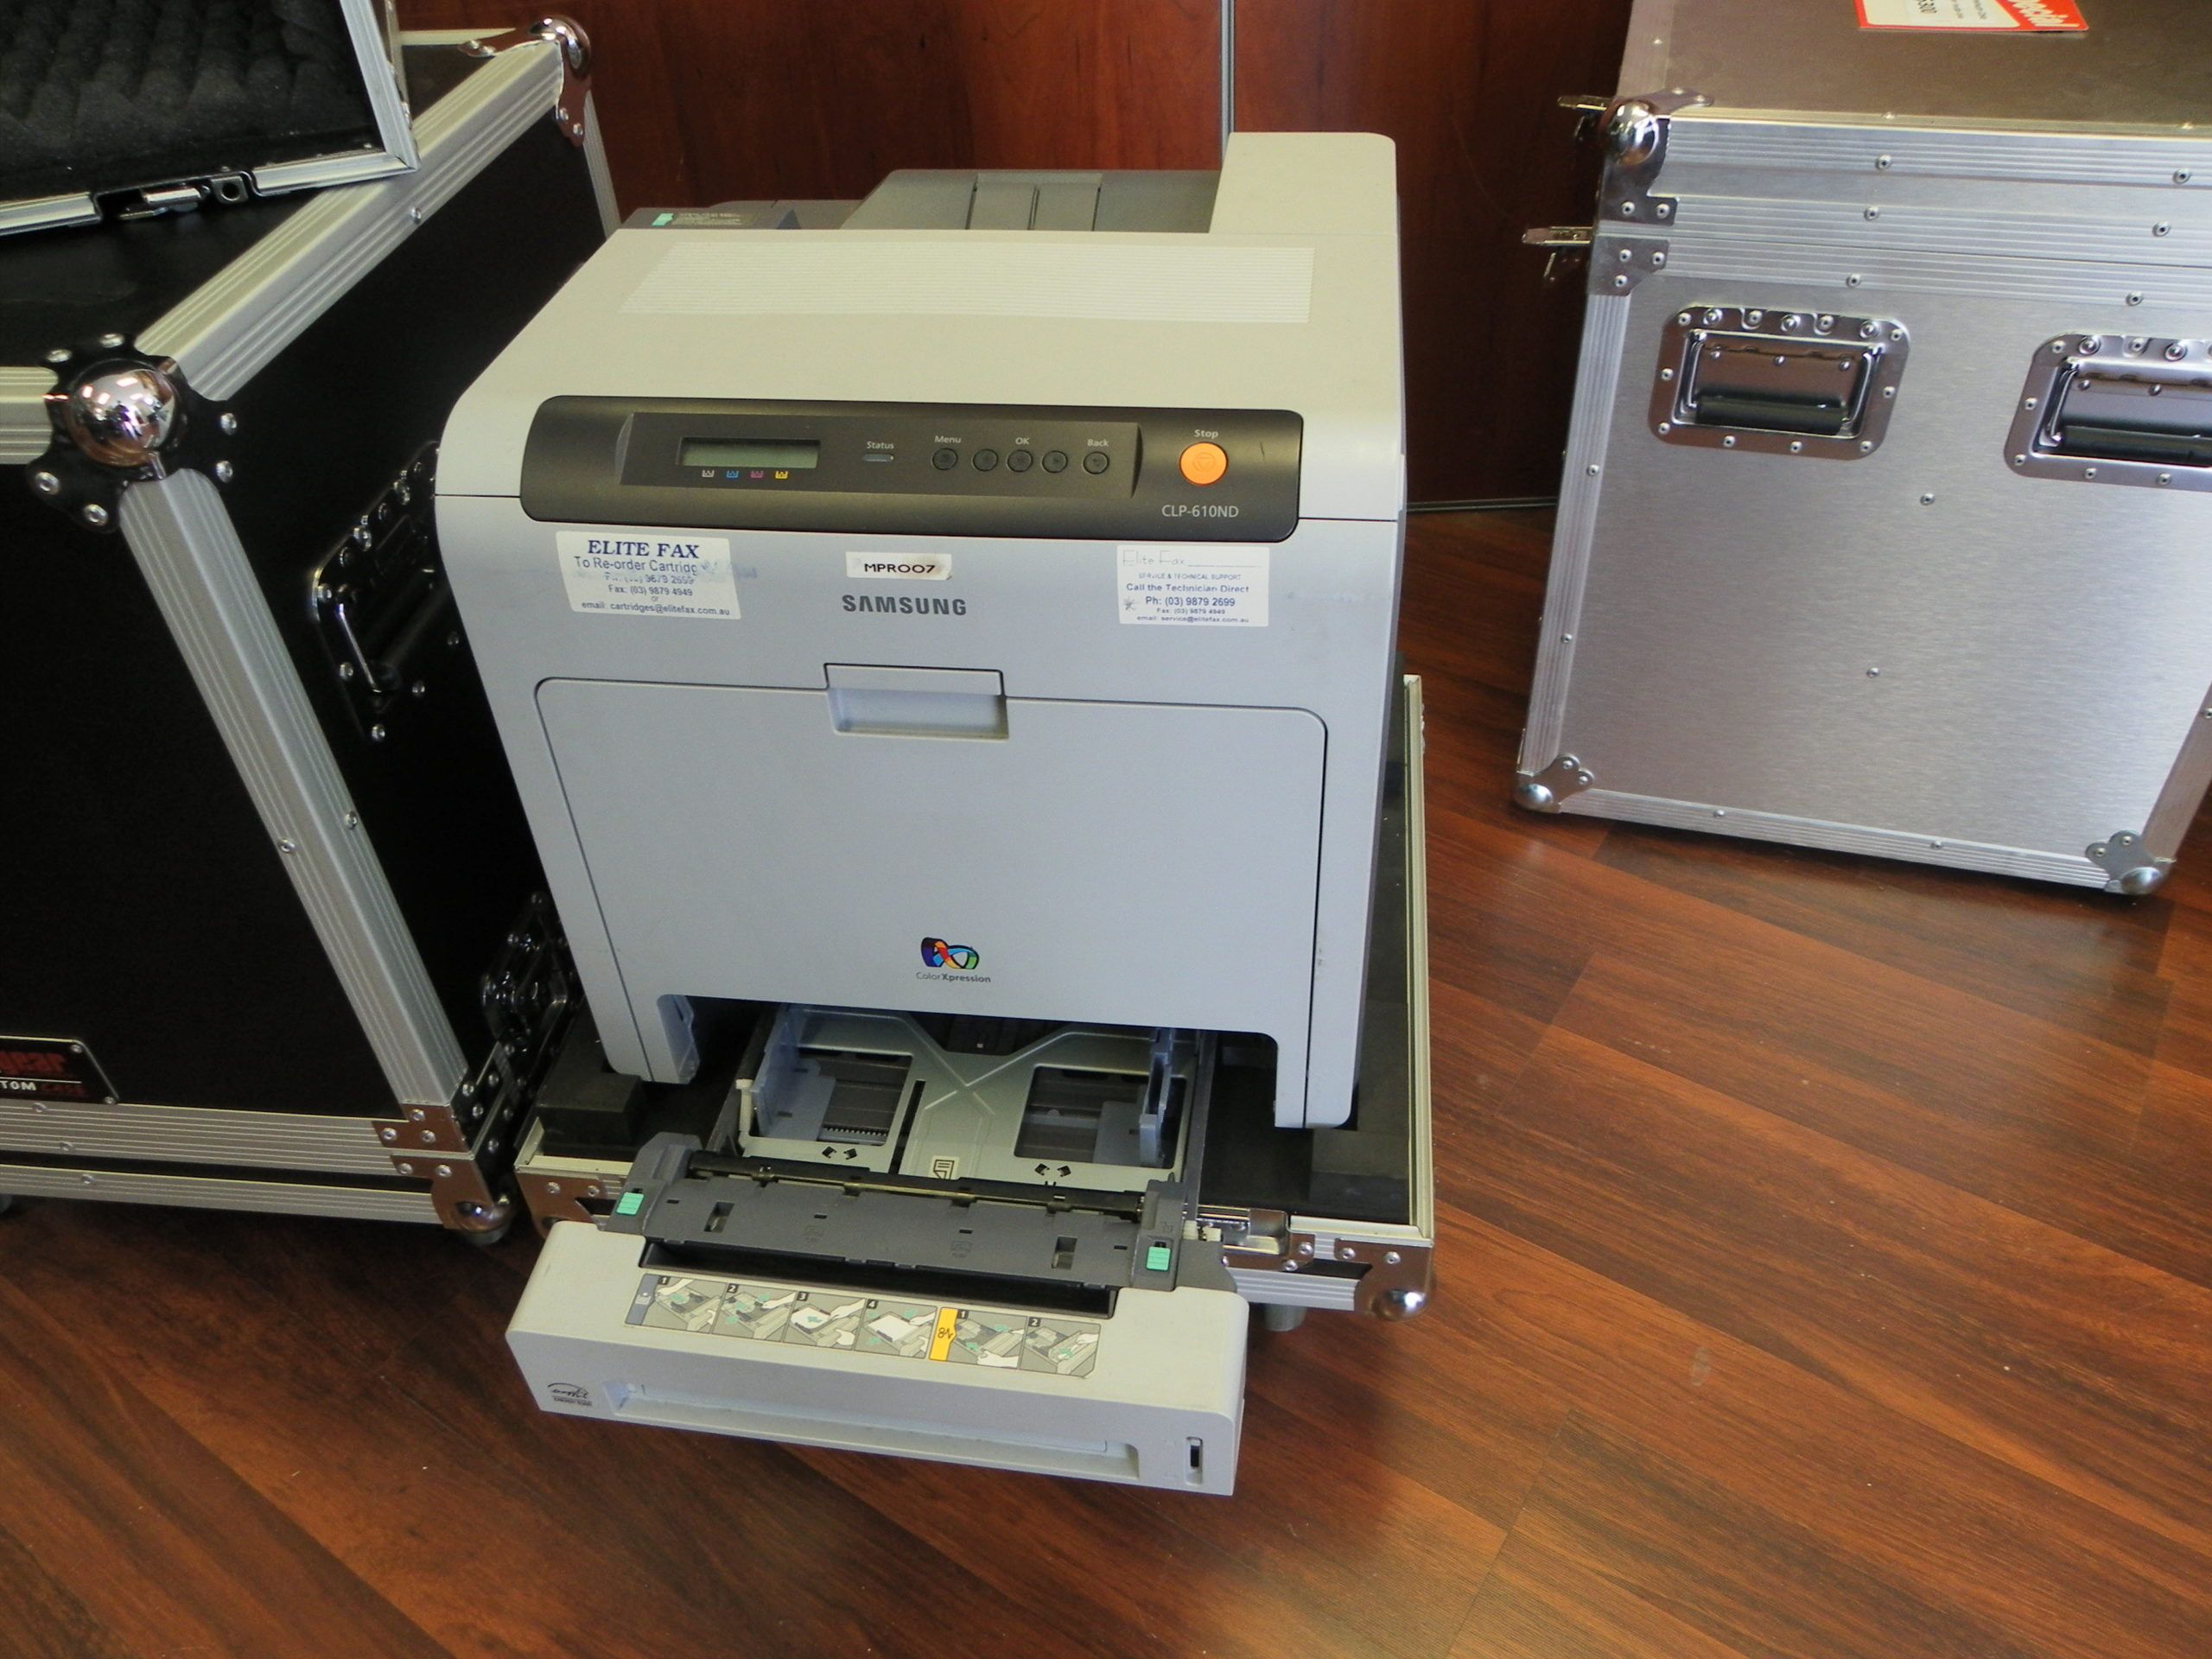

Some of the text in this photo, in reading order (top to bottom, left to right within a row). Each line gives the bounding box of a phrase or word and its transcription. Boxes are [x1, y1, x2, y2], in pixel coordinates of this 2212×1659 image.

[934, 435, 962, 444] Menu
[1194, 429, 1218, 439] Stop
[867, 441, 894, 450] Status
[1087, 438, 1109, 447] Back
[1161, 505, 1239, 518] CLP-610ND
[588, 540, 699, 558] ELITE FAX
[574, 556, 590, 568] To
[593, 557, 645, 570] Re-order
[864, 563, 936, 574] MPR007
[630, 586, 647, 595] (03)
[648, 587, 671, 595] 9879
[672, 588, 693, 596] 4949
[1126, 582, 1145, 591] Call
[1147, 583, 1162, 592] the
[1166, 584, 1217, 593] Technician
[842, 594, 967, 615] SAMSUNG
[1146, 595, 1236, 607] Ph: (03) 9879 2699
